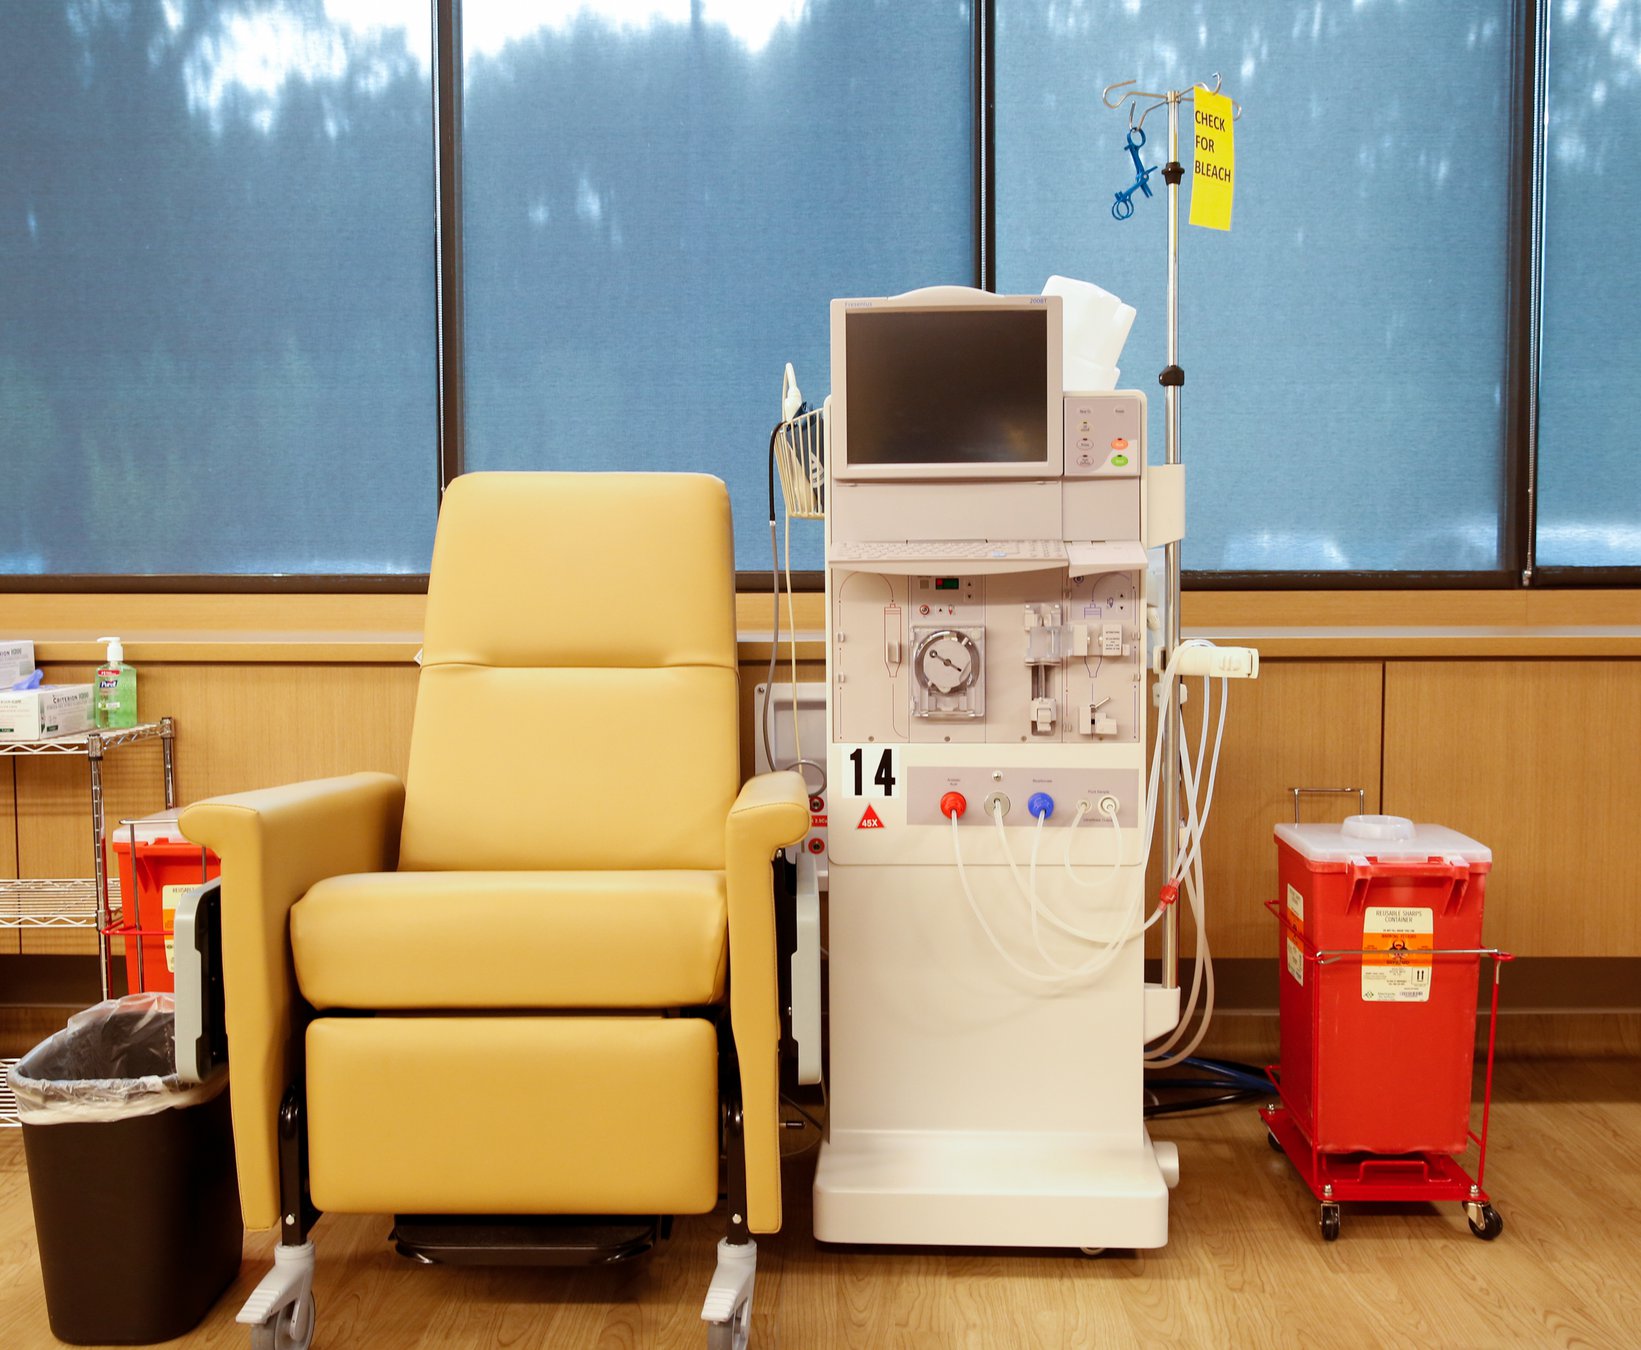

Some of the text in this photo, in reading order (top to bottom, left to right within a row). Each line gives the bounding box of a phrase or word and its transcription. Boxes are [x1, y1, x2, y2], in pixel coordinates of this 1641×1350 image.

[1195, 110, 1225, 132] CHECK
[1195, 135, 1215, 153] FOR
[1194, 160, 1231, 183] BLEACH
[849, 748, 896, 797] 14
[861, 818, 878, 828] 45X
